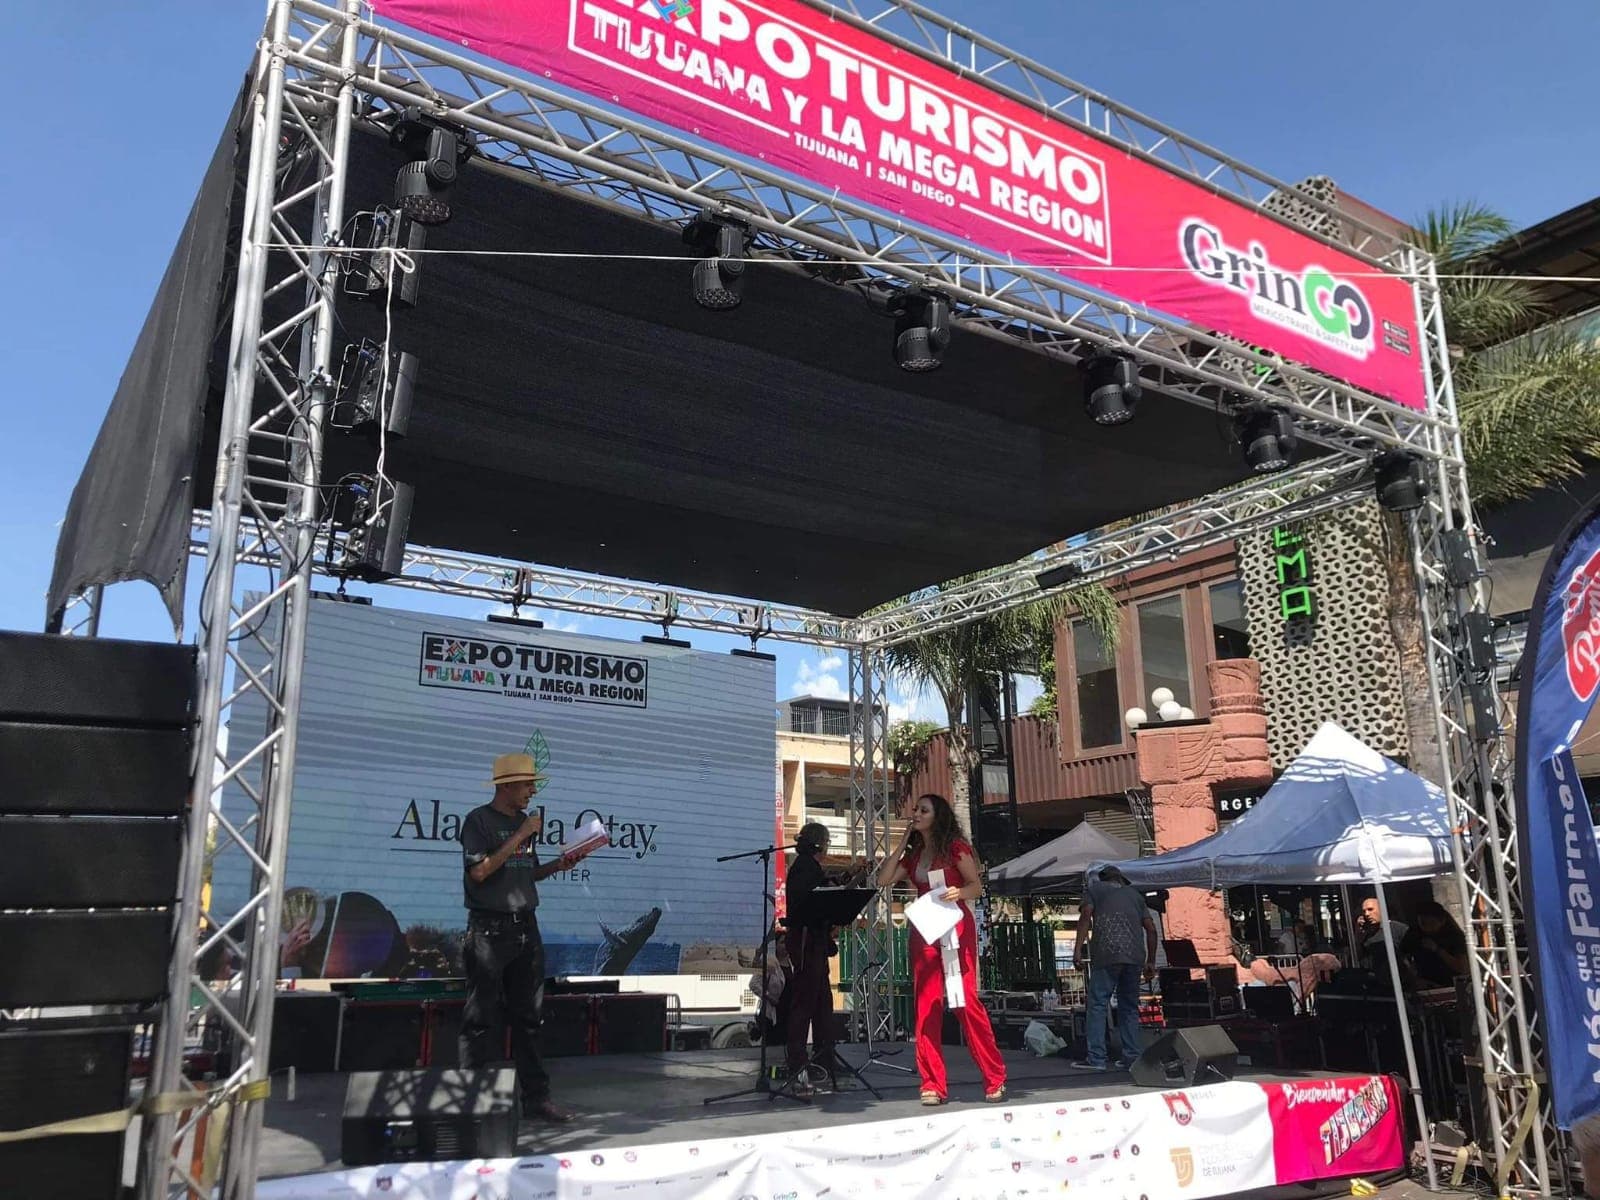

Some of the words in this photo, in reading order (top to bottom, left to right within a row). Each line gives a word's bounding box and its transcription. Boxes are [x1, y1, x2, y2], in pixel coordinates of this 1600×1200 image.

[598, 0, 1101, 205] POTURISMO
[583, 2, 772, 112] TIJUANA
[782, 88, 808, 124] Y
[821, 107, 866, 152] LA
[879, 132, 980, 199] MEGA
[990, 176, 1104, 248] REGION
[793, 132, 859, 170] TIJUANA
[879, 167, 907, 189] SAN
[912, 182, 955, 208] DIEGO
[425, 636, 645, 684] EXPOTURISMO
[425, 665, 495, 685] TIJUANA
[500, 673, 511, 687] Y
[516, 675, 535, 690] LA
[540, 678, 584, 697] MEGA
[589, 683, 644, 702] REGION
[504, 690, 531, 699] TIJUANA
[539, 694, 552, 702] SAN
[553, 695, 573, 703] DIEGO
[1220, 797, 1260, 811] RGE
[548, 869, 591, 882] NTER
[1576, 941, 1592, 982] que
